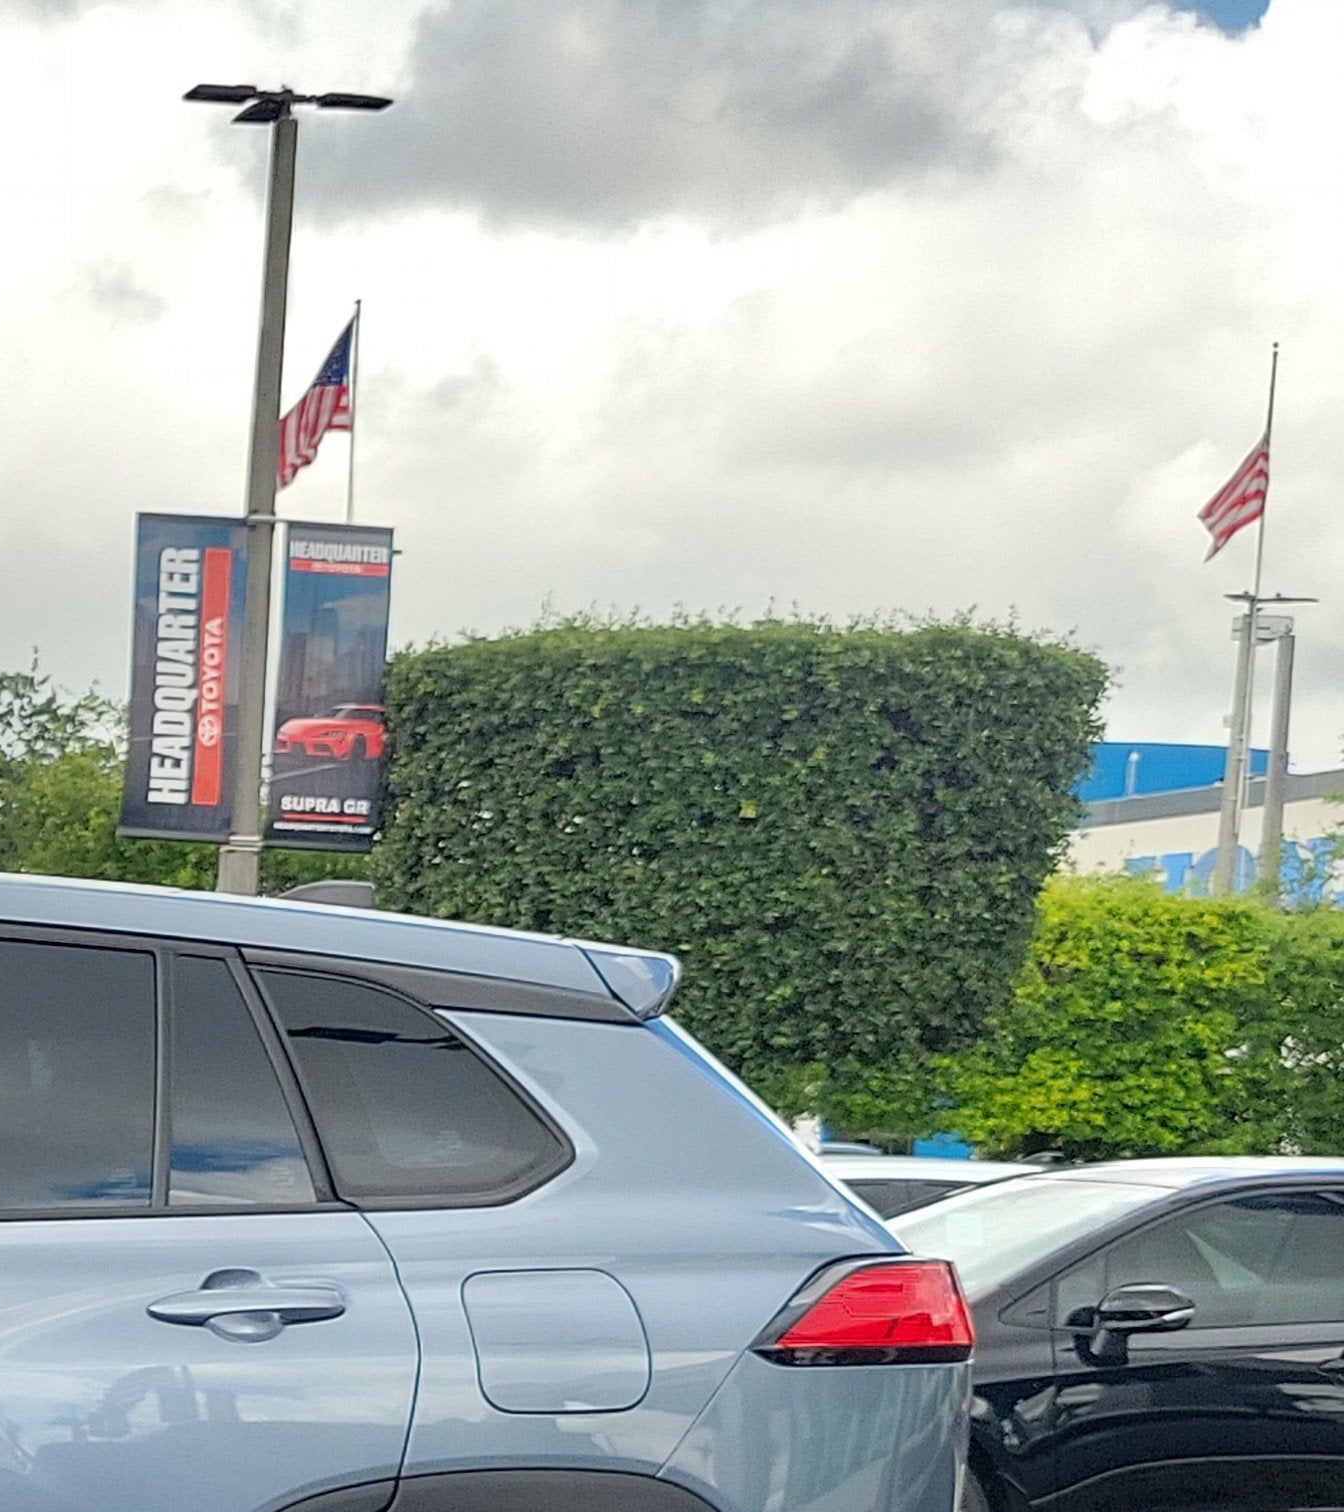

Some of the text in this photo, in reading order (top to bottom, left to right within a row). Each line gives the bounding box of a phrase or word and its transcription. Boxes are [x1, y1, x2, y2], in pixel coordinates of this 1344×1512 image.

[290, 541, 389, 565] HEADQUARTER
[146, 546, 201, 805] HEADQUARTER
[201, 616, 224, 714] TOYOTA
[281, 795, 371, 815] SUPRA GR
